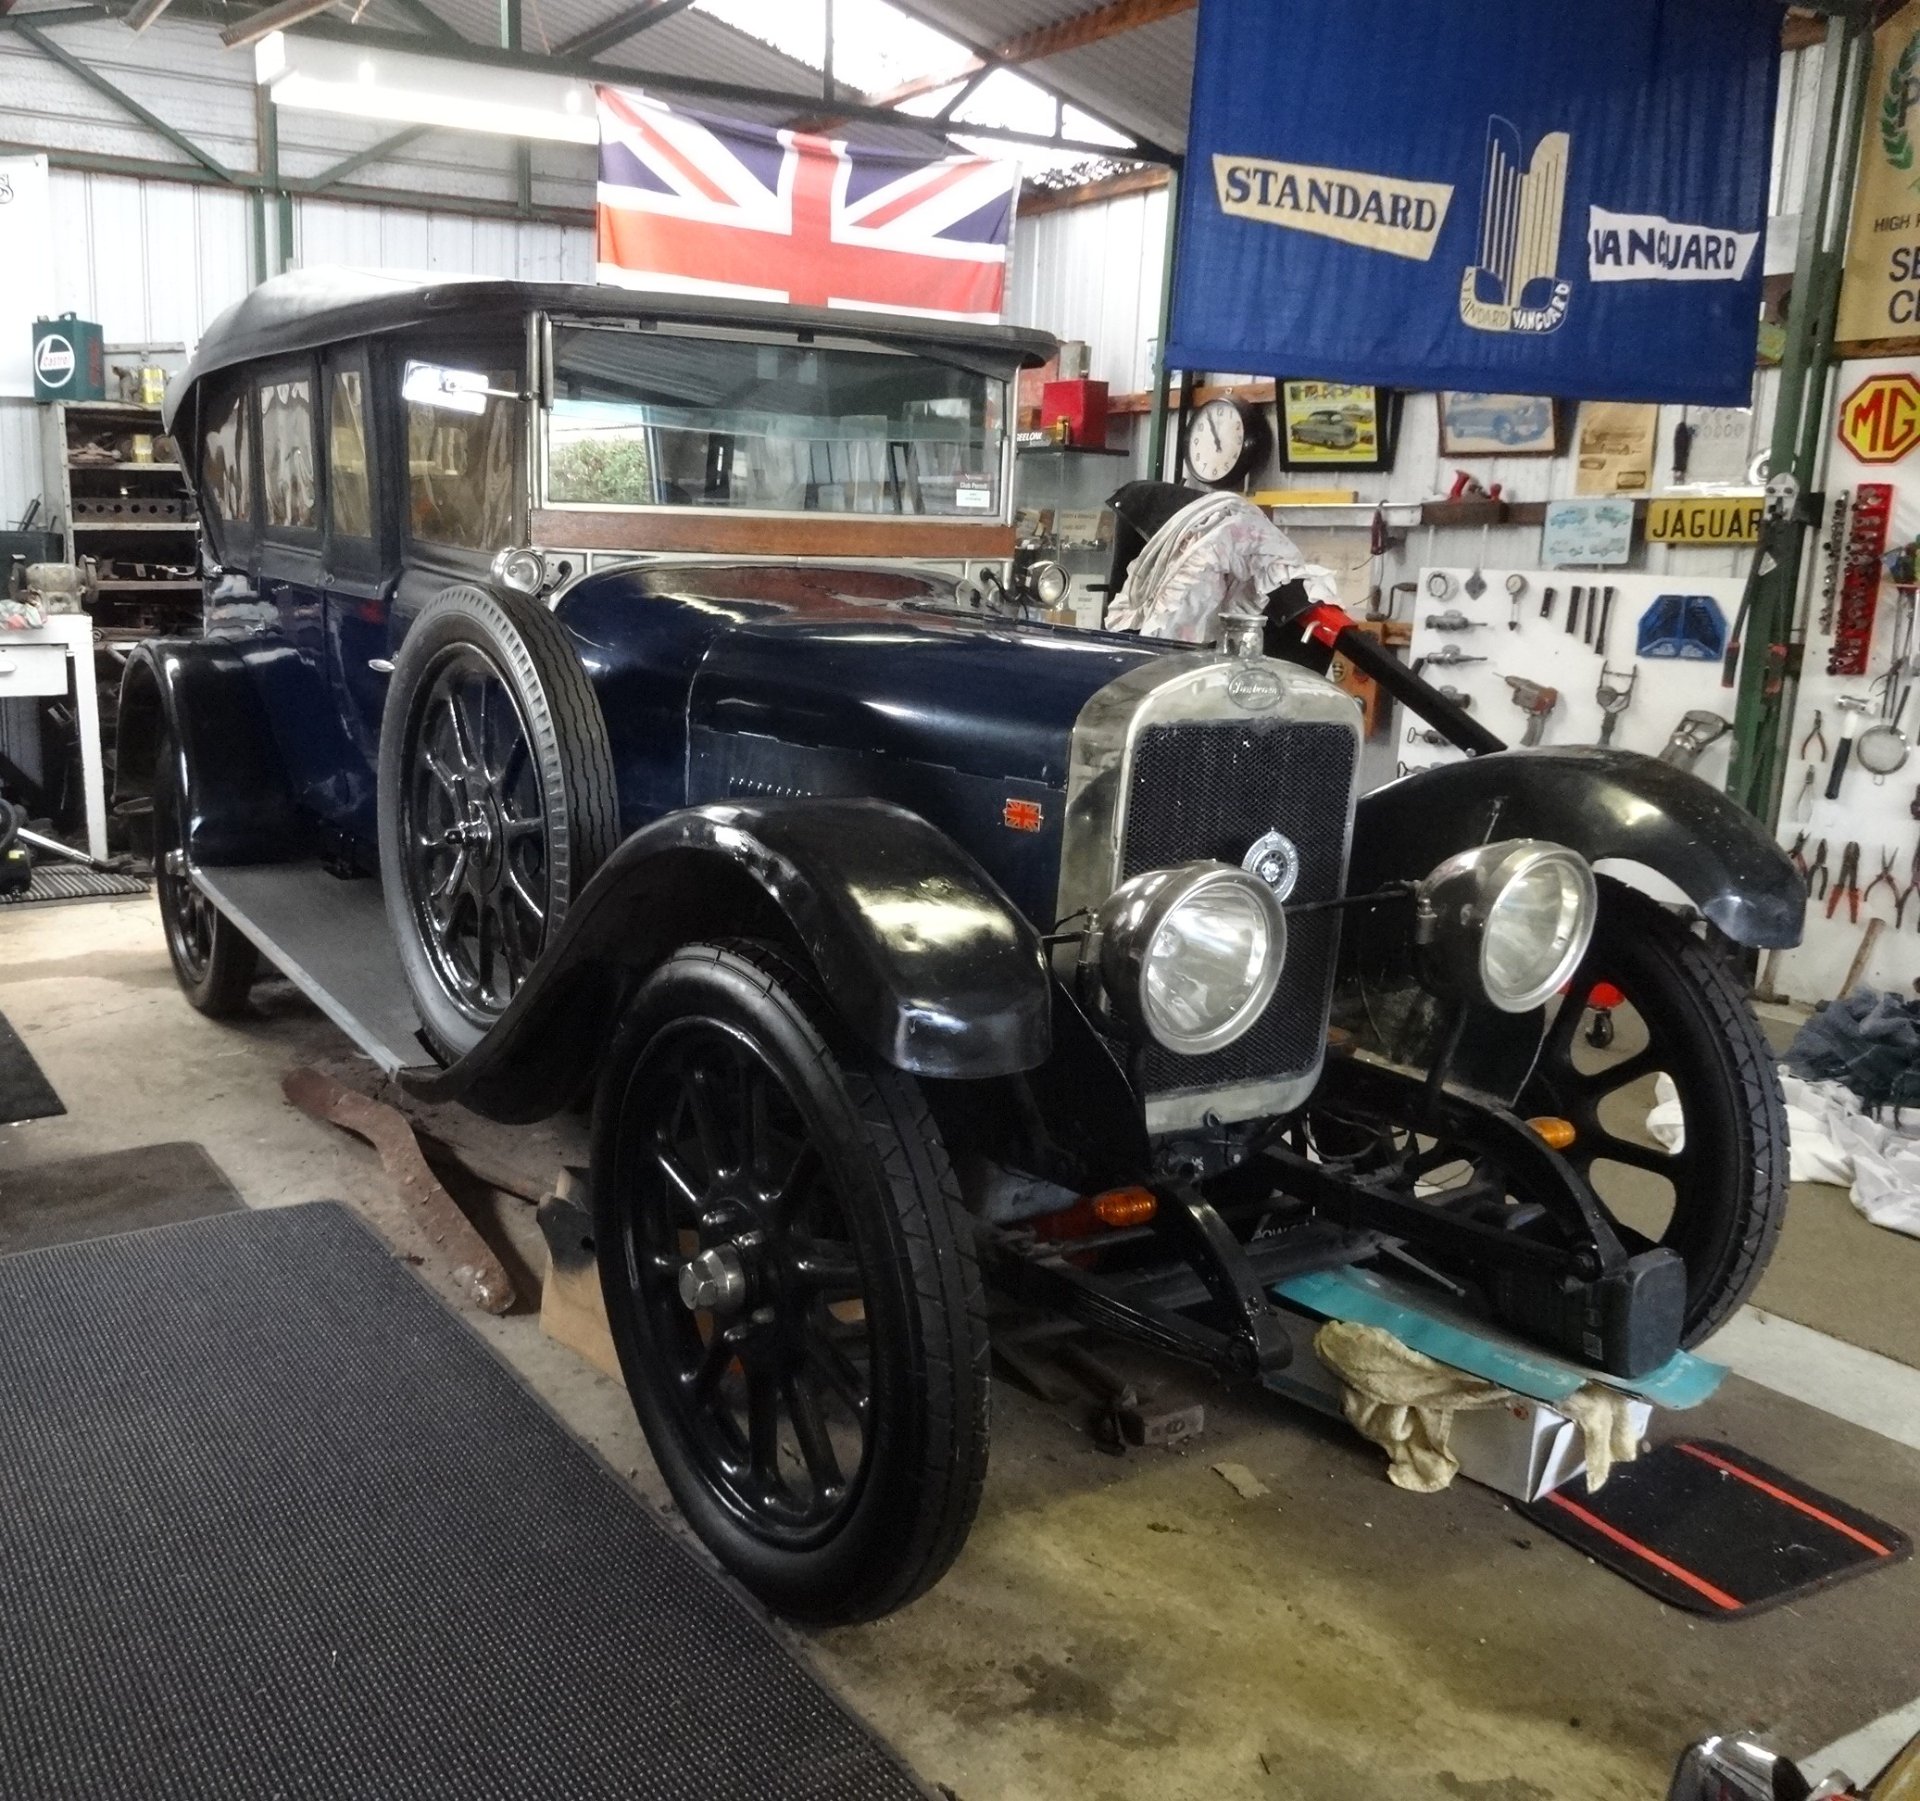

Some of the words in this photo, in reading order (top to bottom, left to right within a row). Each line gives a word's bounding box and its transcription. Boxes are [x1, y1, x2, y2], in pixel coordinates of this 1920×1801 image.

[1225, 166, 1438, 232] STANDARD
[1874, 214, 1909, 233] HIGH
[1594, 228, 1737, 270] VANGUARD
[1512, 282, 1570, 331] VANGUARD
[1851, 387, 1917, 452] MG
[1652, 508, 1762, 539] JAGUAR
